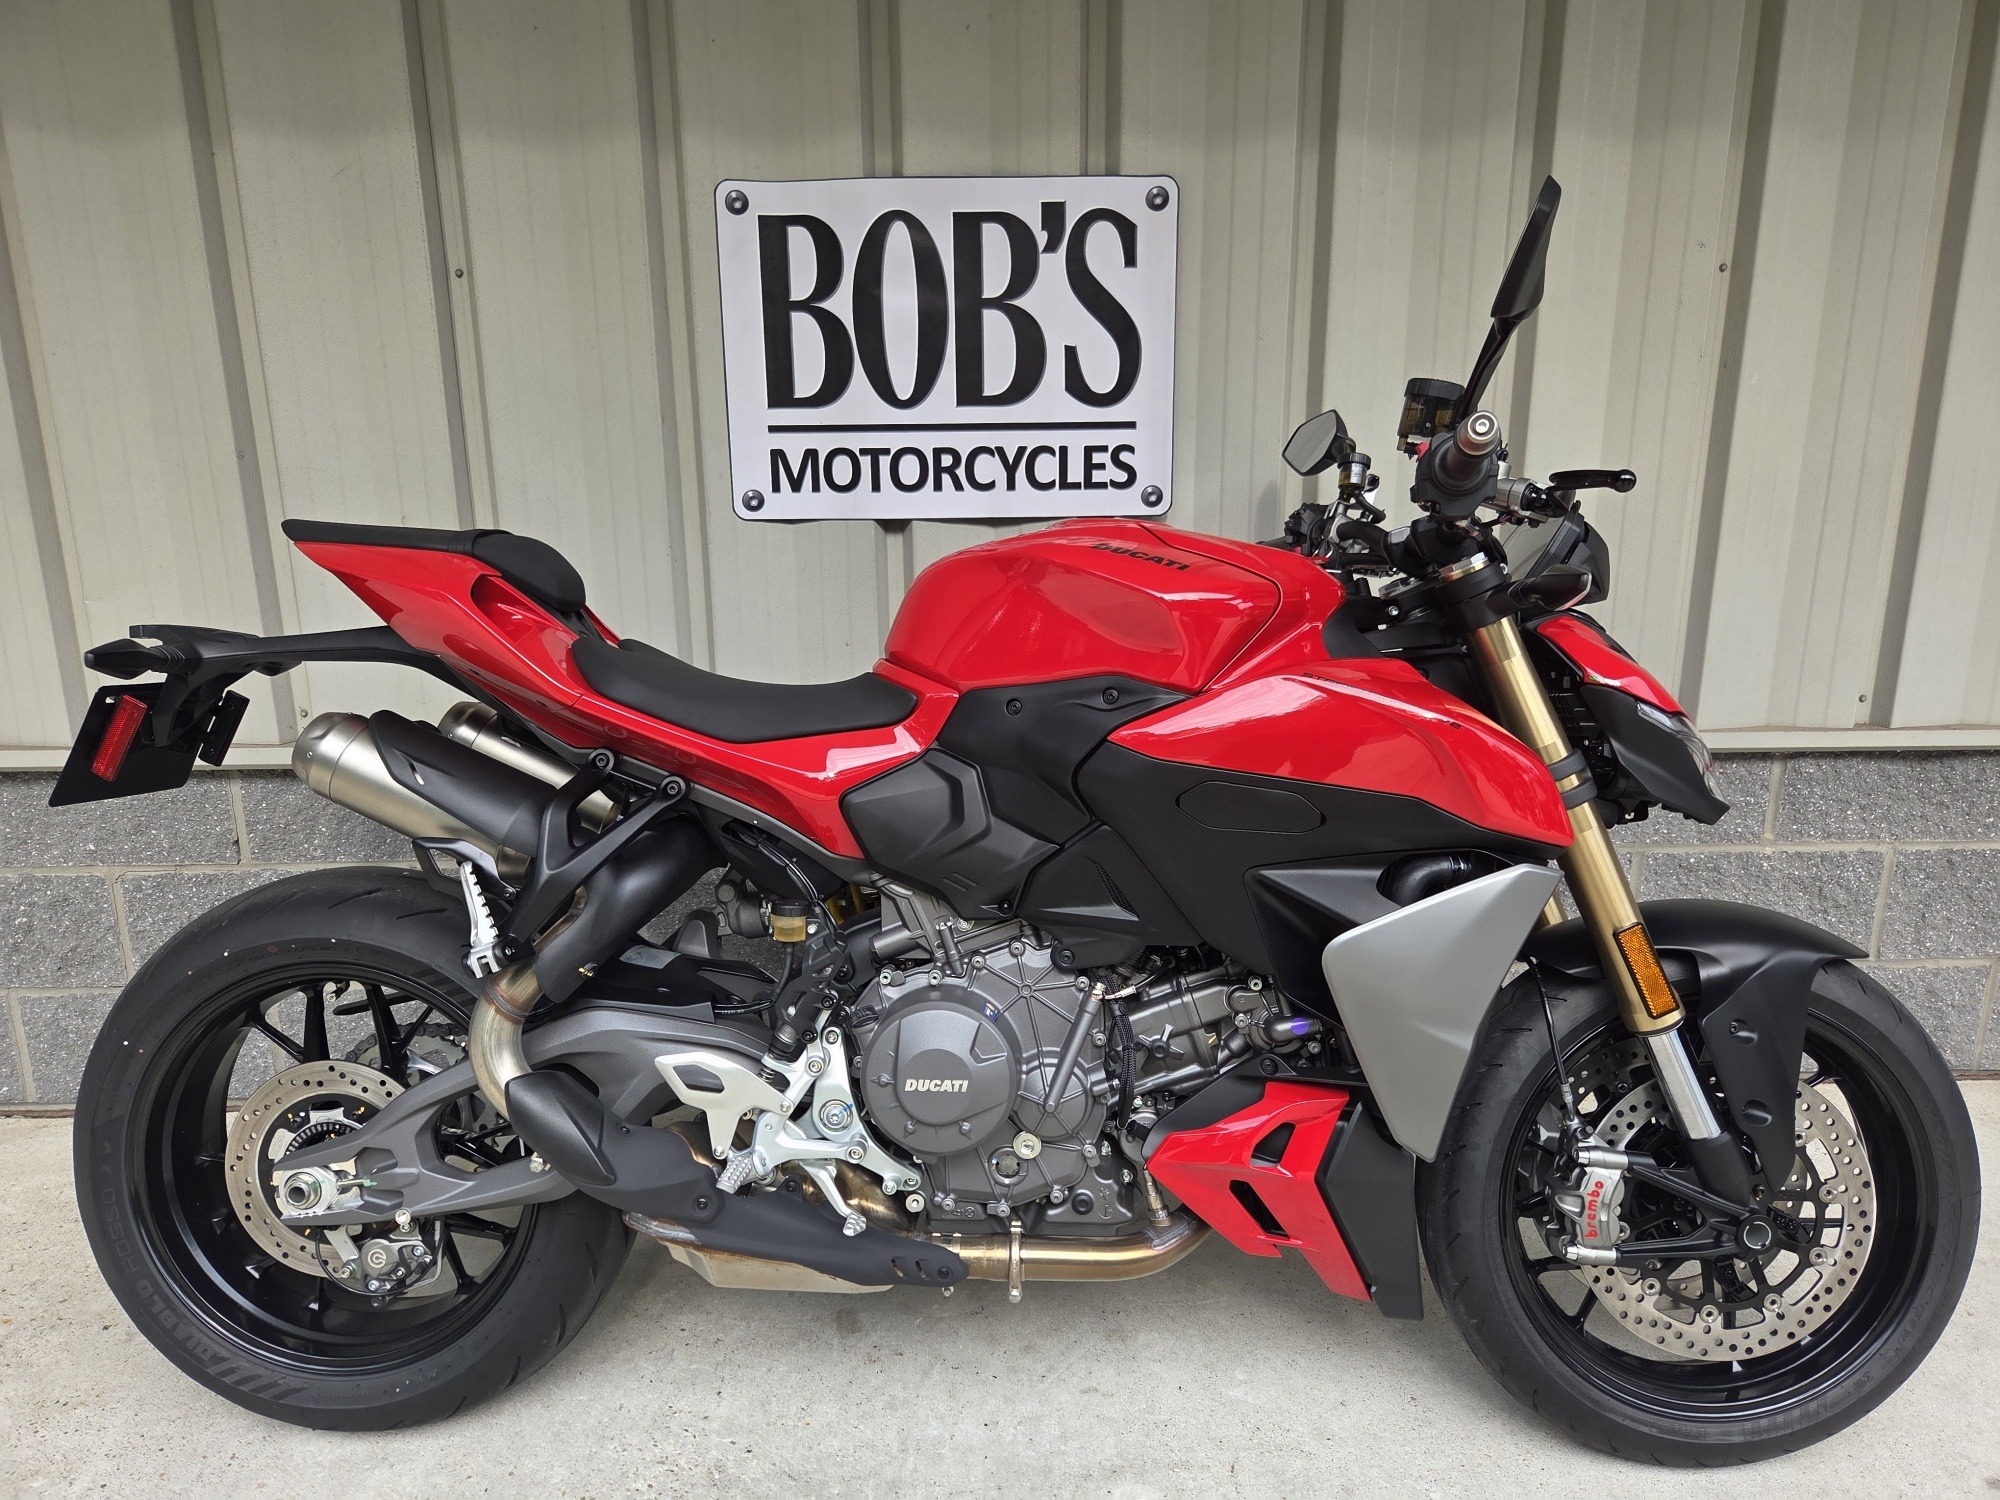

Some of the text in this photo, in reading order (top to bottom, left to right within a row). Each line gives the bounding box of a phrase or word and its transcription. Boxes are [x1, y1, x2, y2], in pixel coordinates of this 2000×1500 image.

[757, 200, 1142, 410] BOB'S
[769, 444, 1138, 494] MOTORCYCLES
[1091, 543, 1192, 571] DUCATI
[904, 1078, 969, 1093] DUCATI
[102, 1188, 140, 1274] ROSSO
[1585, 1180, 1604, 1239] brembo
[135, 1278, 220, 1363] DIABLO
